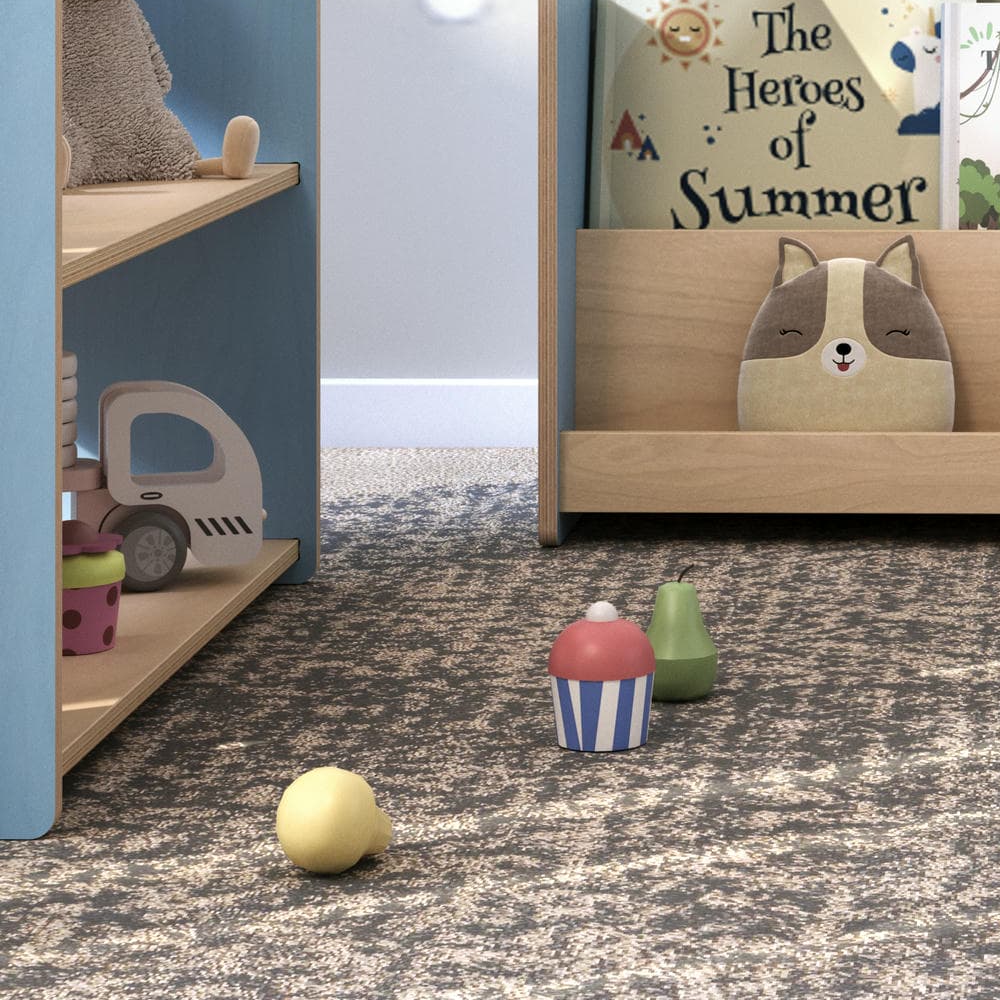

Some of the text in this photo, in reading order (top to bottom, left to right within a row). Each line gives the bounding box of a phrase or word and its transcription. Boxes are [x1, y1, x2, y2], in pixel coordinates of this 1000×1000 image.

[752, 2, 832, 58] The
[723, 65, 866, 114] Heroes
[769, 109, 817, 170] of
[670, 167, 928, 229] Summer
